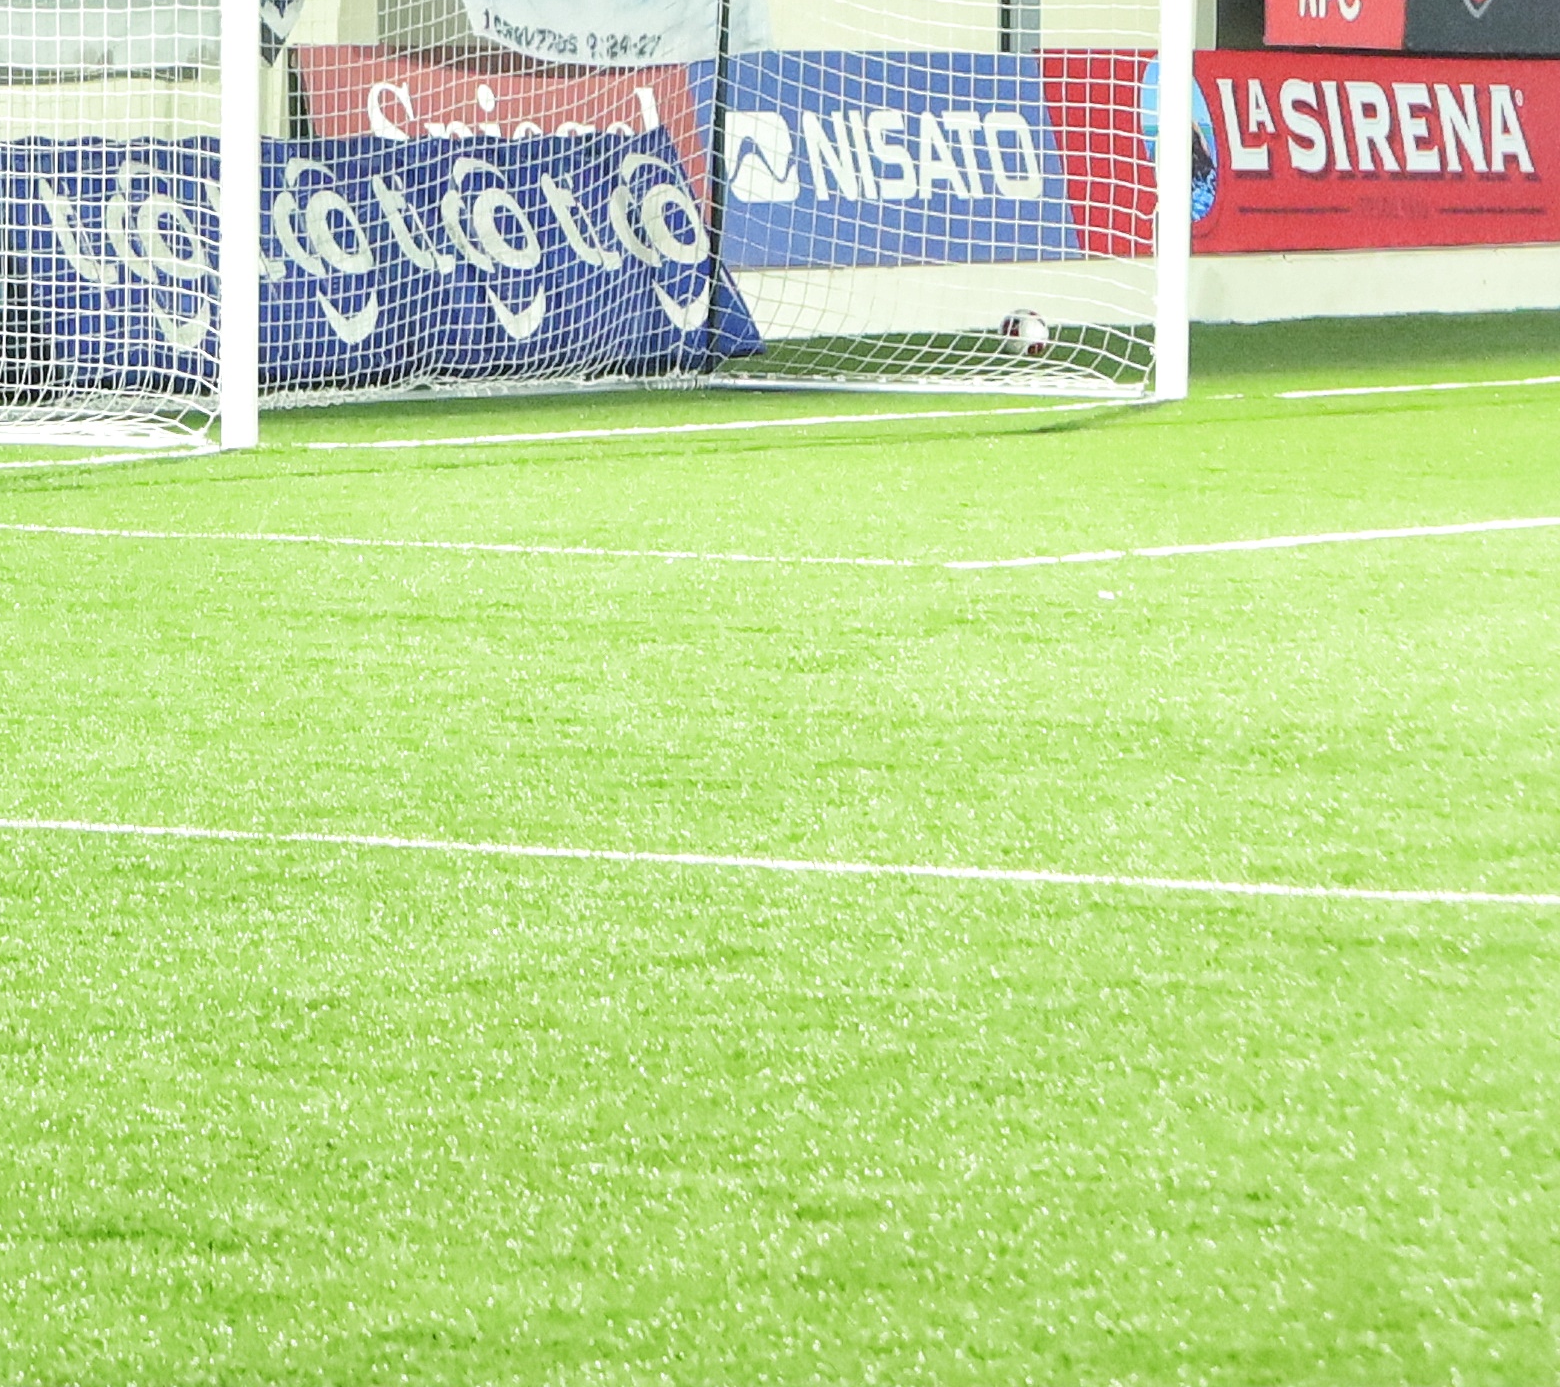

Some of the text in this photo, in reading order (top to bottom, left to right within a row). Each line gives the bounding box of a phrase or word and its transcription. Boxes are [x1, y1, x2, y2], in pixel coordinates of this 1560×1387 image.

[801, 109, 1045, 204] NISATO
[1214, 77, 1534, 173] LA SIRENA
